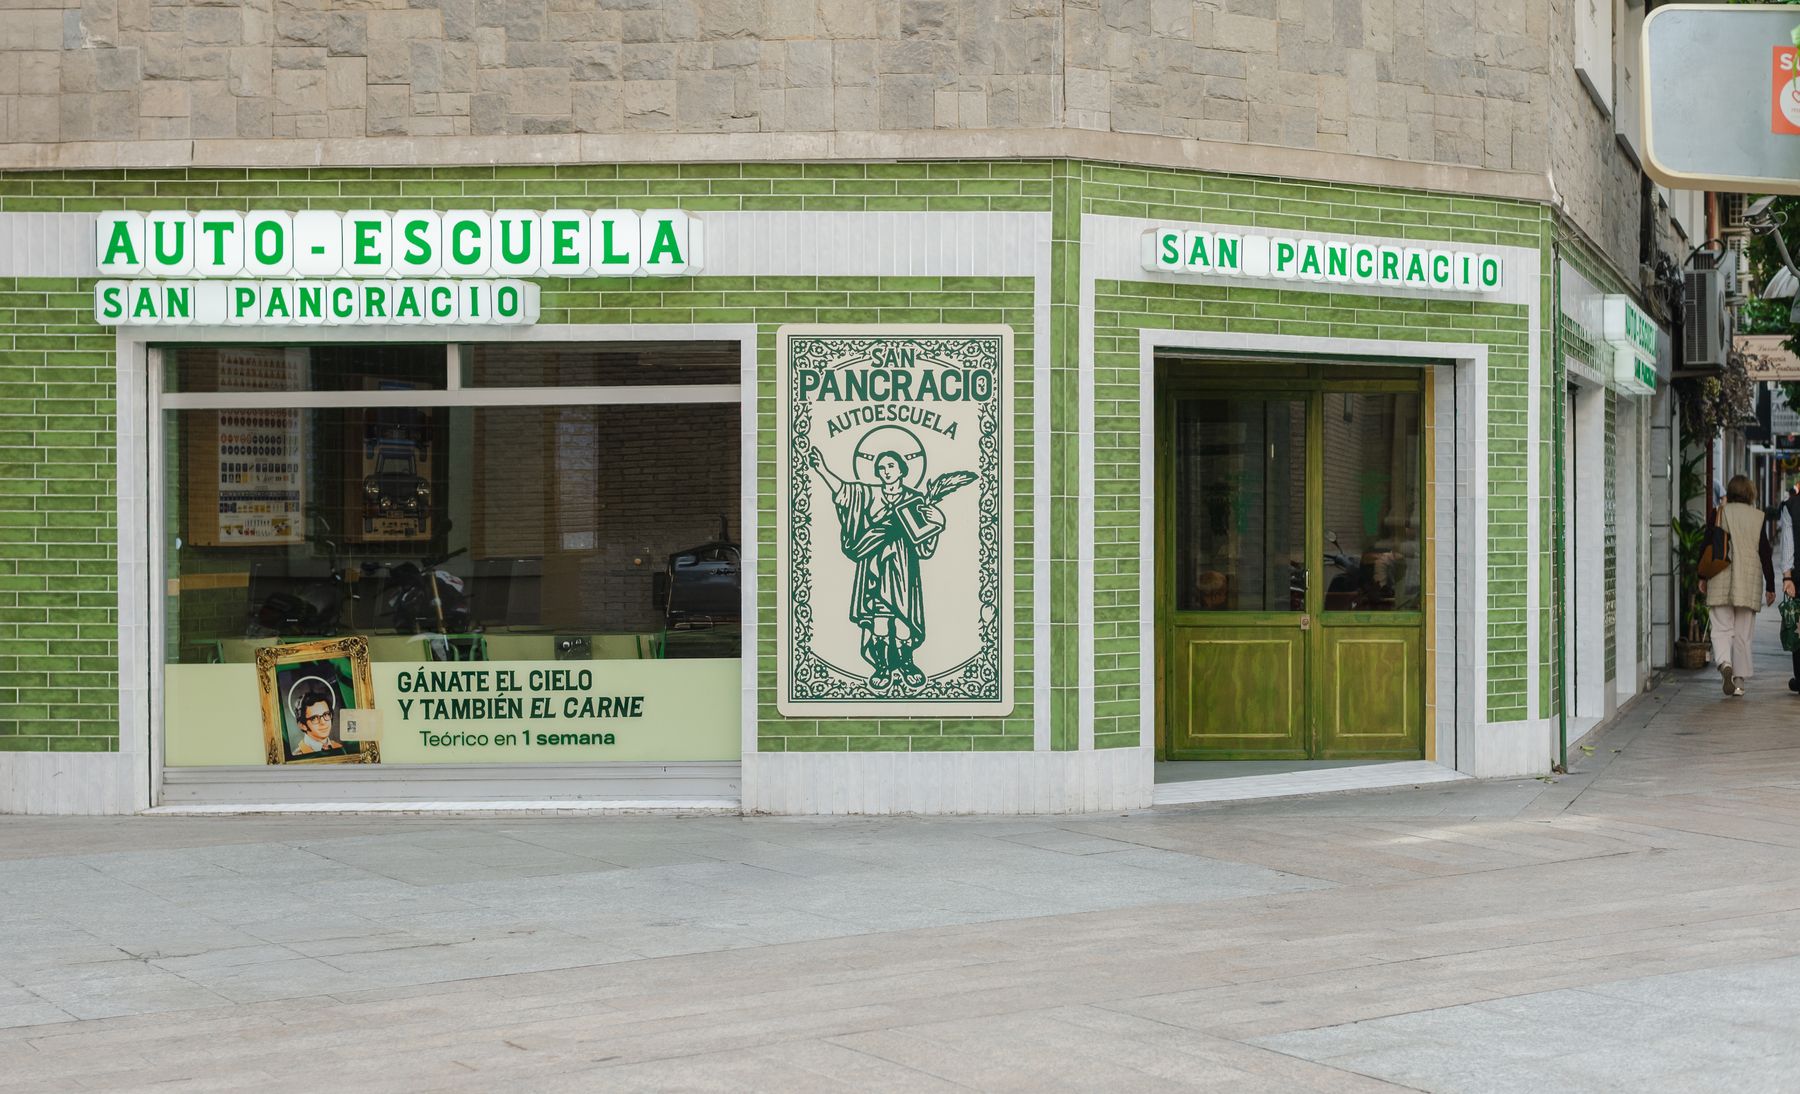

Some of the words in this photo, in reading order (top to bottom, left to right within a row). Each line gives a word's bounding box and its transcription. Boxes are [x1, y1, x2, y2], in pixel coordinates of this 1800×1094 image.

[1779, 52, 1800, 71] S
[1161, 233, 1239, 269] SAN
[1277, 242, 1498, 287] PANCRACIO
[103, 286, 189, 319] SAN
[235, 286, 518, 319] PANCRACIO
[870, 347, 916, 368] SAN
[798, 368, 993, 403] PANCRACIO
[826, 403, 959, 441] AUTOESCUELA
[397, 666, 490, 693] GÁNATE
[495, 670, 523, 692] EL
[529, 669, 593, 692] CIELO
[397, 699, 414, 720] Y
[419, 692, 524, 720] TAMBIÉN
[529, 697, 557, 719] EL
[563, 696, 645, 718] CARNE
[418, 730, 489, 747] Teórico
[493, 734, 517, 746] en
[522, 730, 530, 745] 1
[536, 733, 616, 746] semana
